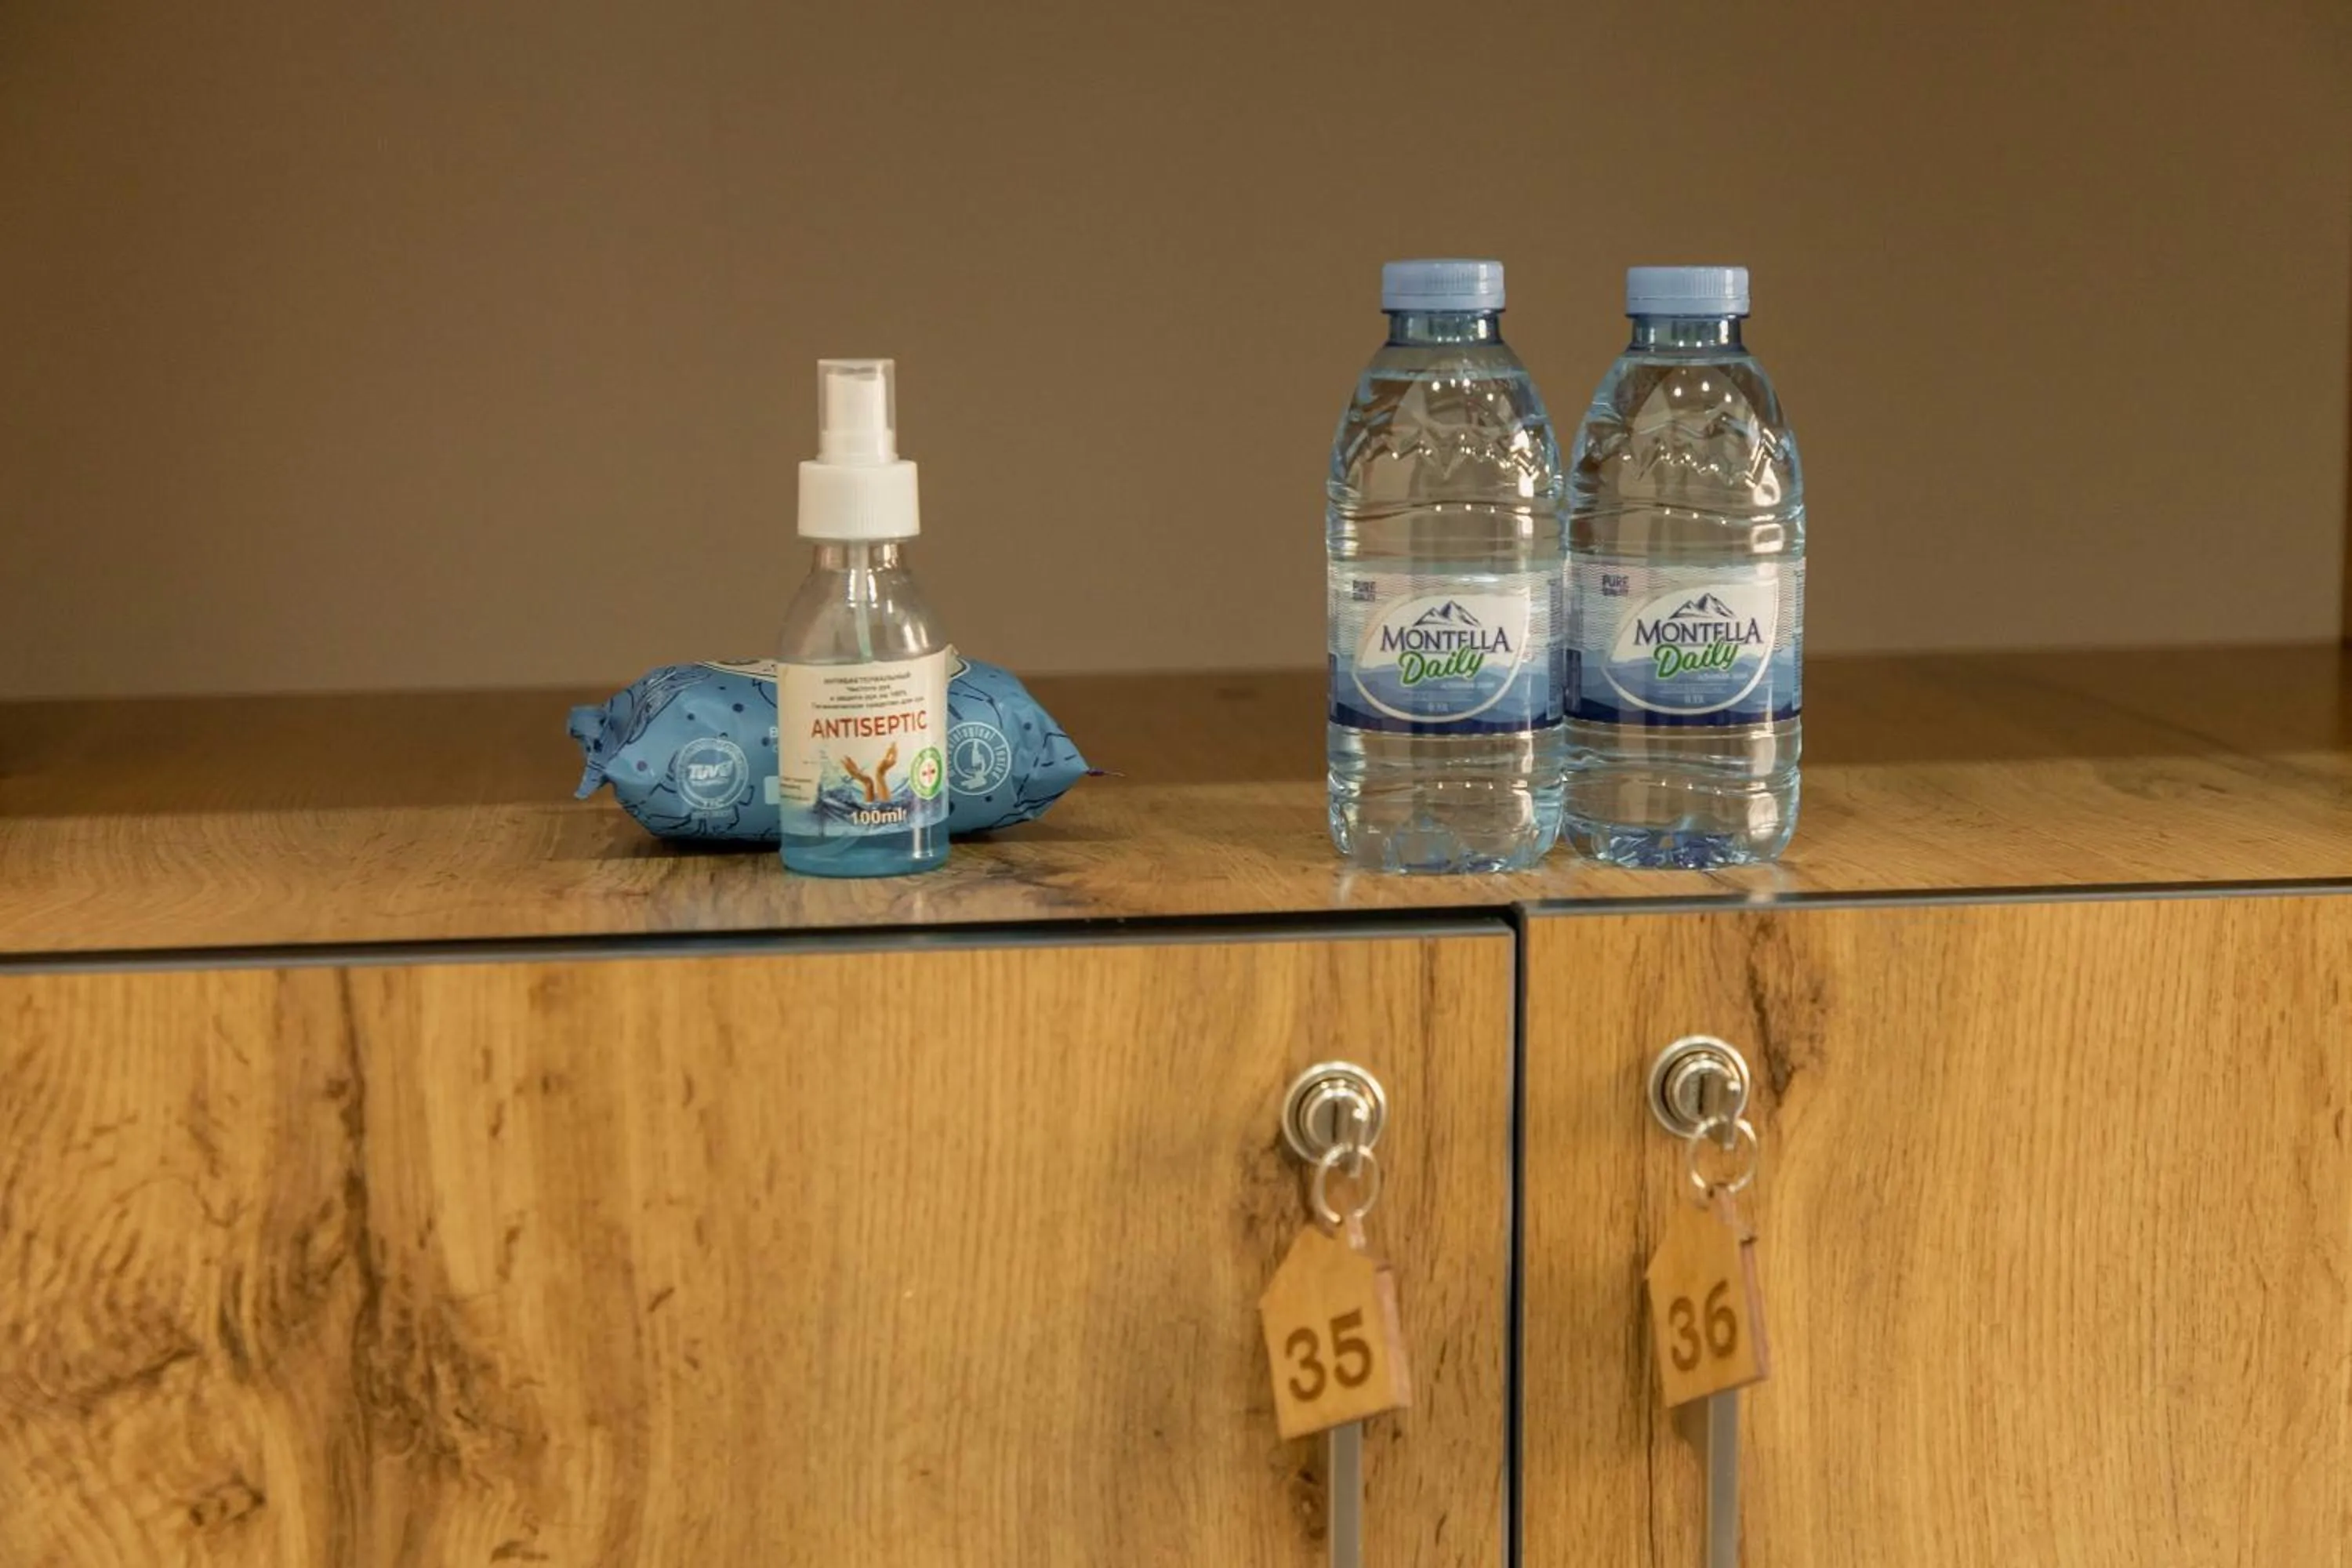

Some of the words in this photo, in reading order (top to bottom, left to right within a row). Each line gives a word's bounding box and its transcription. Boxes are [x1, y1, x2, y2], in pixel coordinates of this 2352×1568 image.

[1380, 626, 1513, 653] MONTELLA
[1634, 618, 1763, 646] MONTELLA
[1399, 645, 1485, 685] Daily
[1653, 637, 1739, 679] Daily
[811, 710, 927, 738] ANTISEPTIC
[1668, 1279, 1737, 1372] 36
[1285, 1308, 1374, 1402] 35
